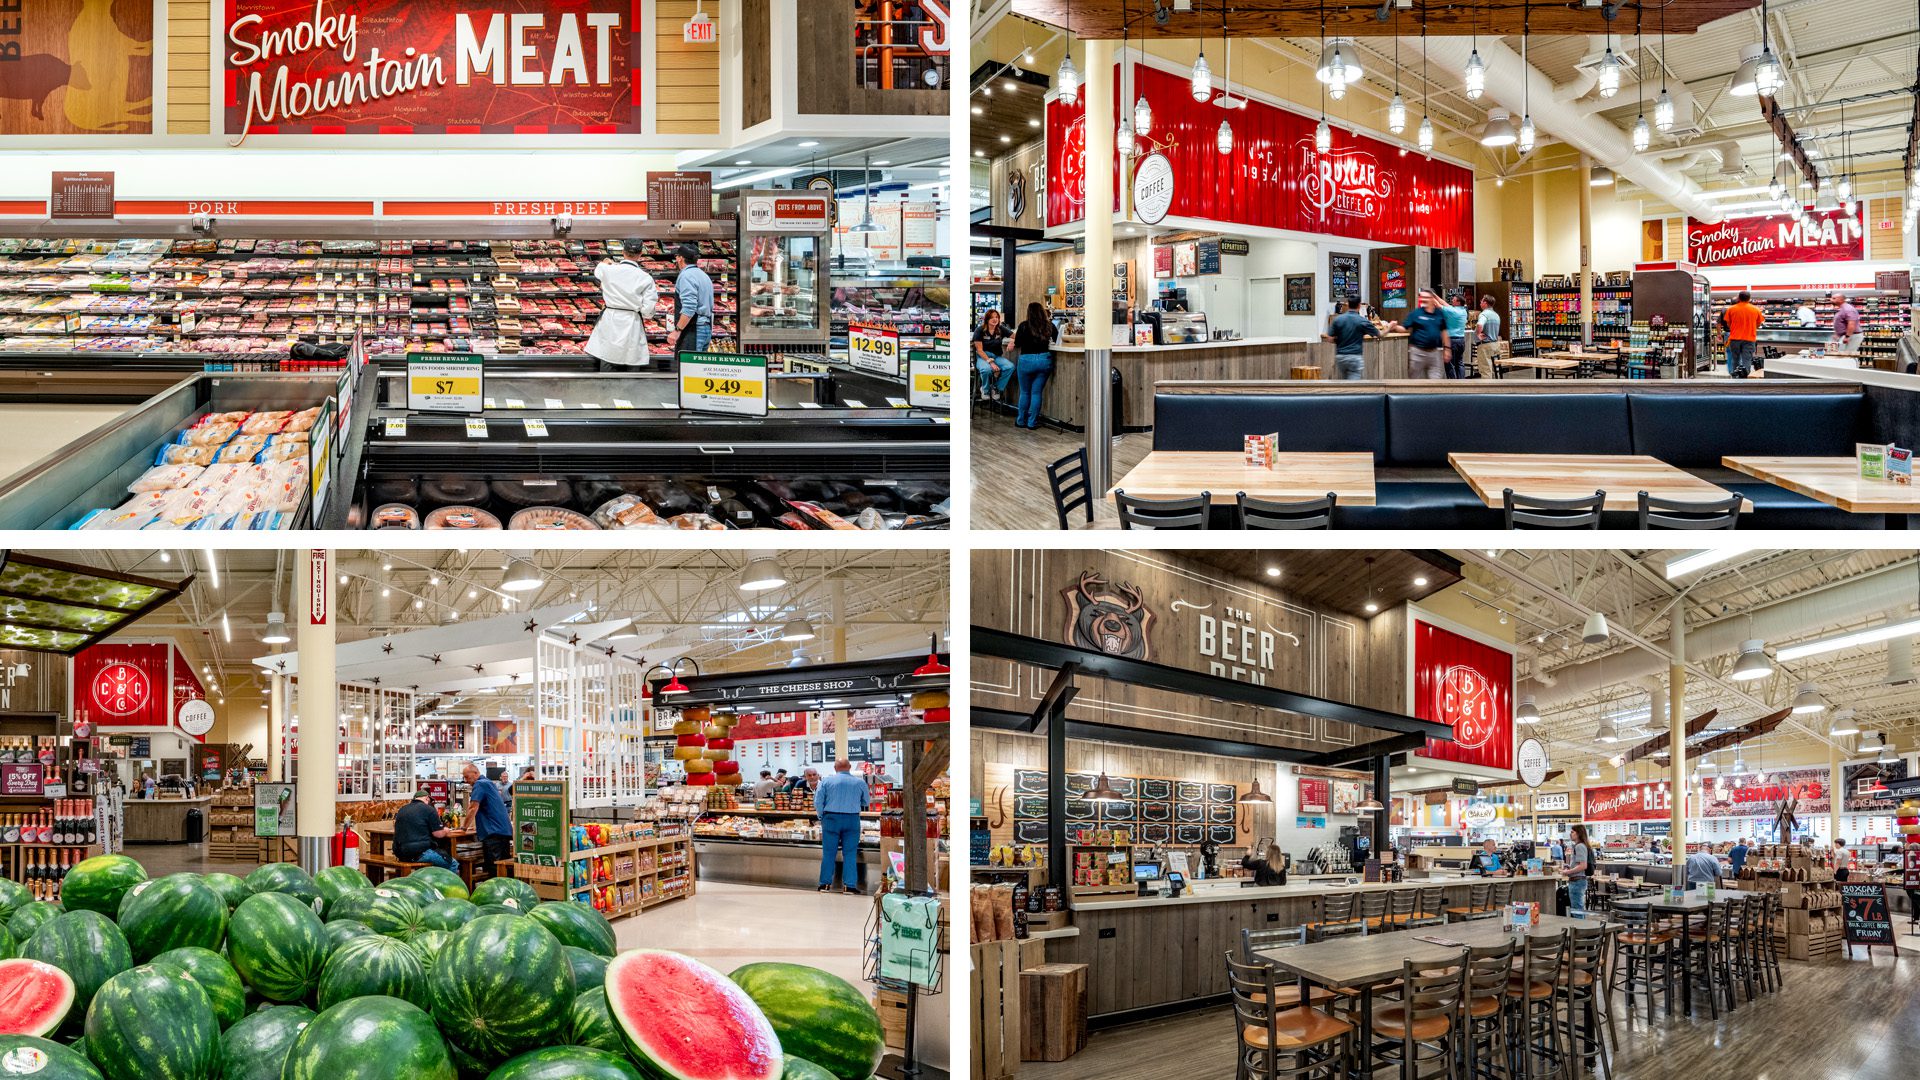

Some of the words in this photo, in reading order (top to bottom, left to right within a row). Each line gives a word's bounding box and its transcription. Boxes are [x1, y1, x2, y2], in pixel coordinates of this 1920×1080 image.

[229, 0, 358, 66] Smoky
[692, 23, 712, 40] EXIT
[456, 13, 622, 88] MEAT
[229, 47, 448, 147] Mountain
[1140, 178, 1164, 200] COFFEE
[188, 202, 239, 214] PORK
[493, 203, 555, 215] FRESH
[562, 203, 611, 215] BEEF
[1690, 223, 1739, 248] Smoky
[1778, 218, 1851, 248] MEAT
[1222, 242, 1248, 251] DEPARTURES
[1696, 236, 1776, 266] Mountain
[854, 337, 892, 356] 12.99
[436, 380, 454, 394] $7
[704, 378, 741, 394] 9.49
[1226, 606, 1252, 622] THE
[1200, 614, 1275, 670] BEER
[118, 667, 126, 680] B
[101, 682, 108, 695] C
[759, 686, 780, 694] THE
[782, 682, 822, 692] CHEESE
[824, 680, 854, 690] SHOP
[1462, 674, 1474, 694] B
[185, 712, 207, 723] COFFEE
[1524, 758, 1541, 768] COFFEE
[7, 780, 24, 788] Every
[24, 780, 38, 788] Day
[1540, 796, 1565, 804] READ
[1733, 782, 1822, 804] SAMMY'S
[1587, 788, 1638, 815] Kannapolis
[1644, 790, 1672, 811] DEL
[1844, 799, 1896, 809] SMOKEHOUSE
[522, 808, 536, 817] TABLE
[538, 808, 555, 817] ITSELF
[1872, 912, 1882, 920] LB
